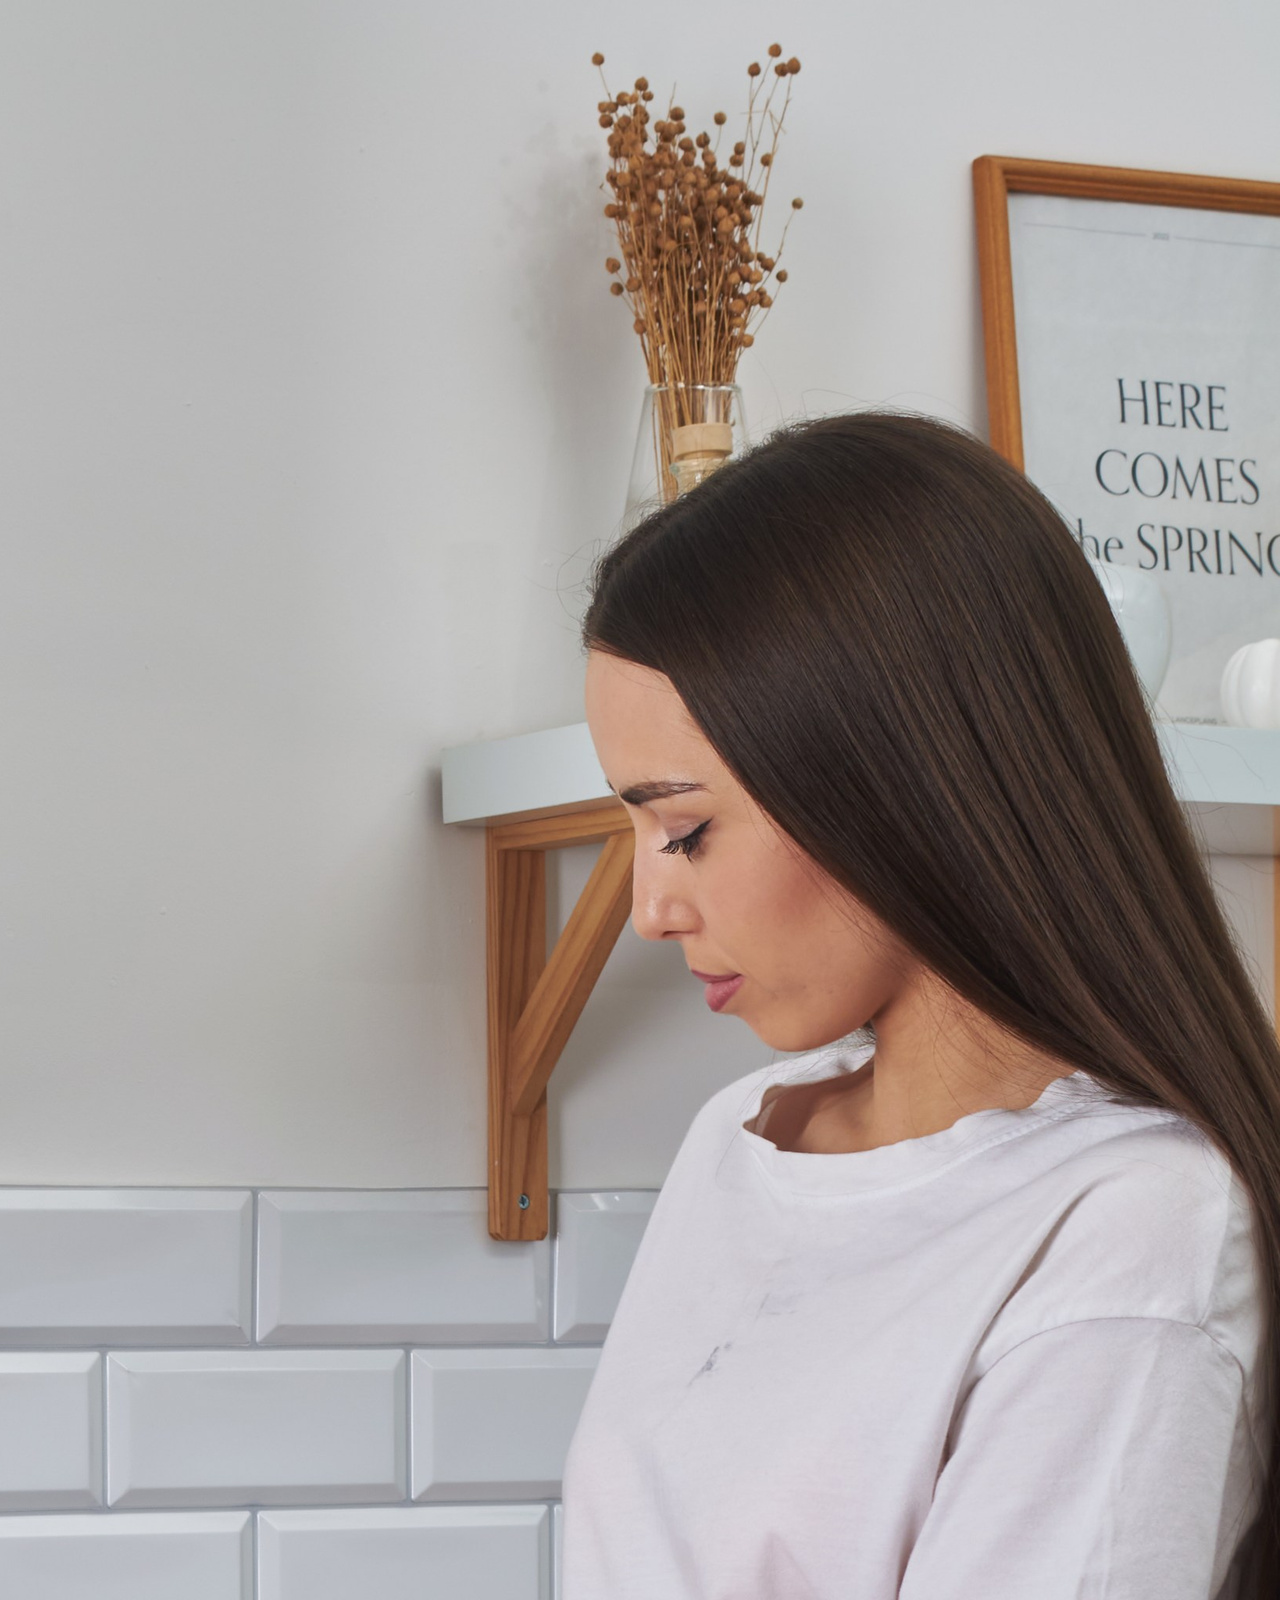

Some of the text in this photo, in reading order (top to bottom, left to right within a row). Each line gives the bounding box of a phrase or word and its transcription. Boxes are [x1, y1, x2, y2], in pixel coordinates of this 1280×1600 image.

[1116, 378, 1230, 432] HERE
[1094, 448, 1260, 506] COMES
[1076, 517, 1125, 565] he
